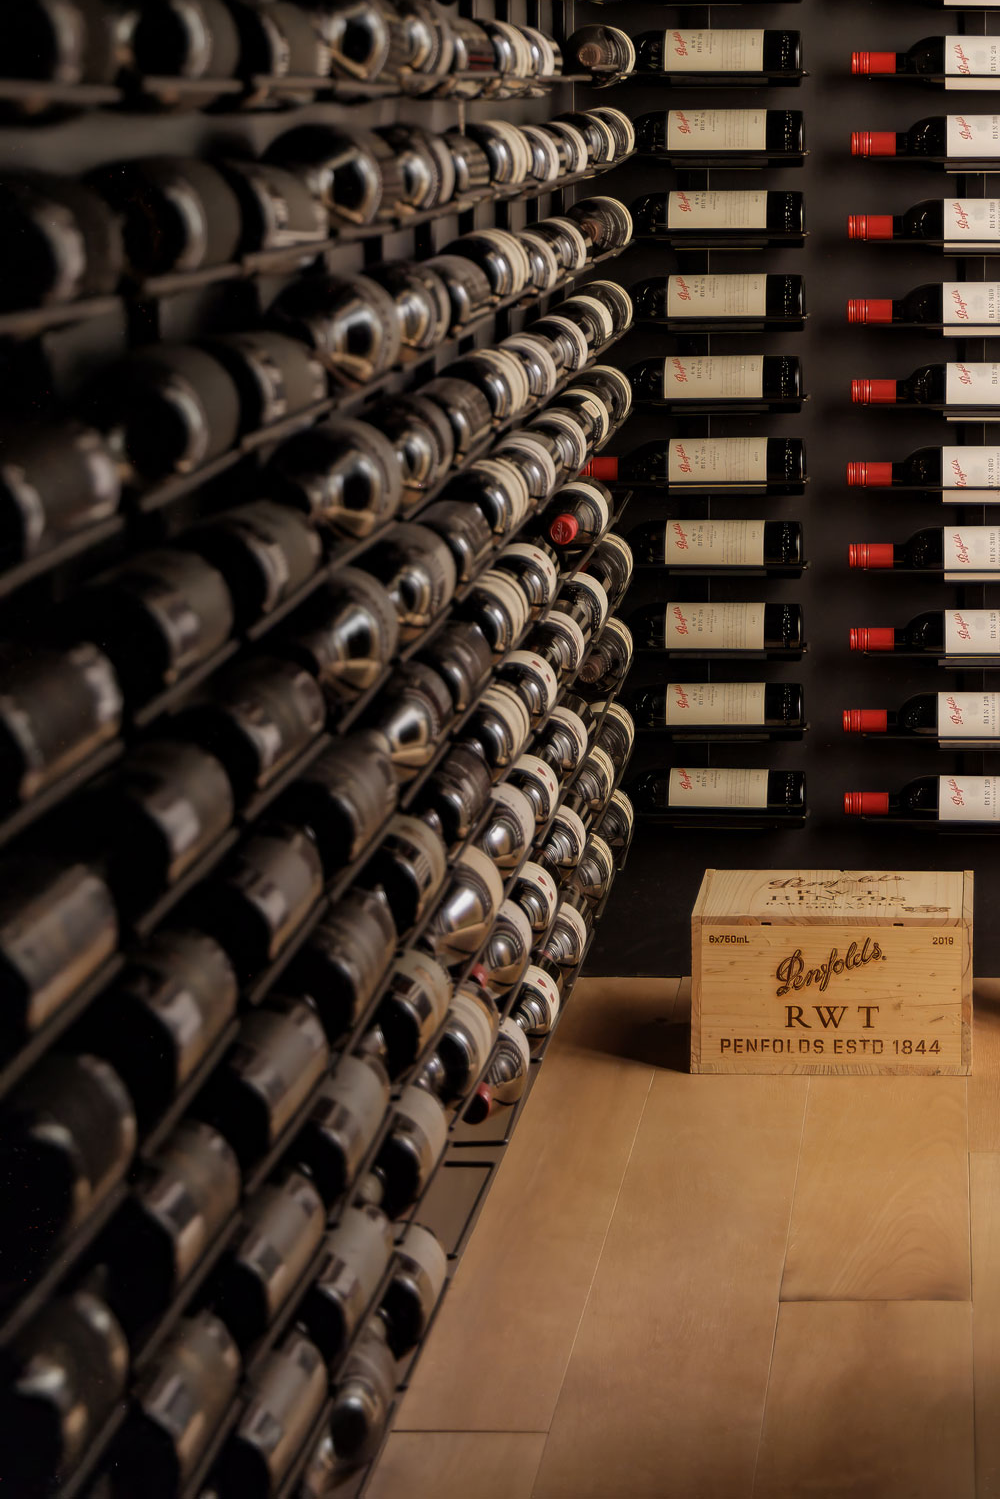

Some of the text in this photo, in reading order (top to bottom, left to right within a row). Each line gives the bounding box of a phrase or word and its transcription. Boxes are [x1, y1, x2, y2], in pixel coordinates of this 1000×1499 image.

[784, 1005, 880, 1029] RWT
[719, 1038, 941, 1055] PENFOLDS ESTD 1844
